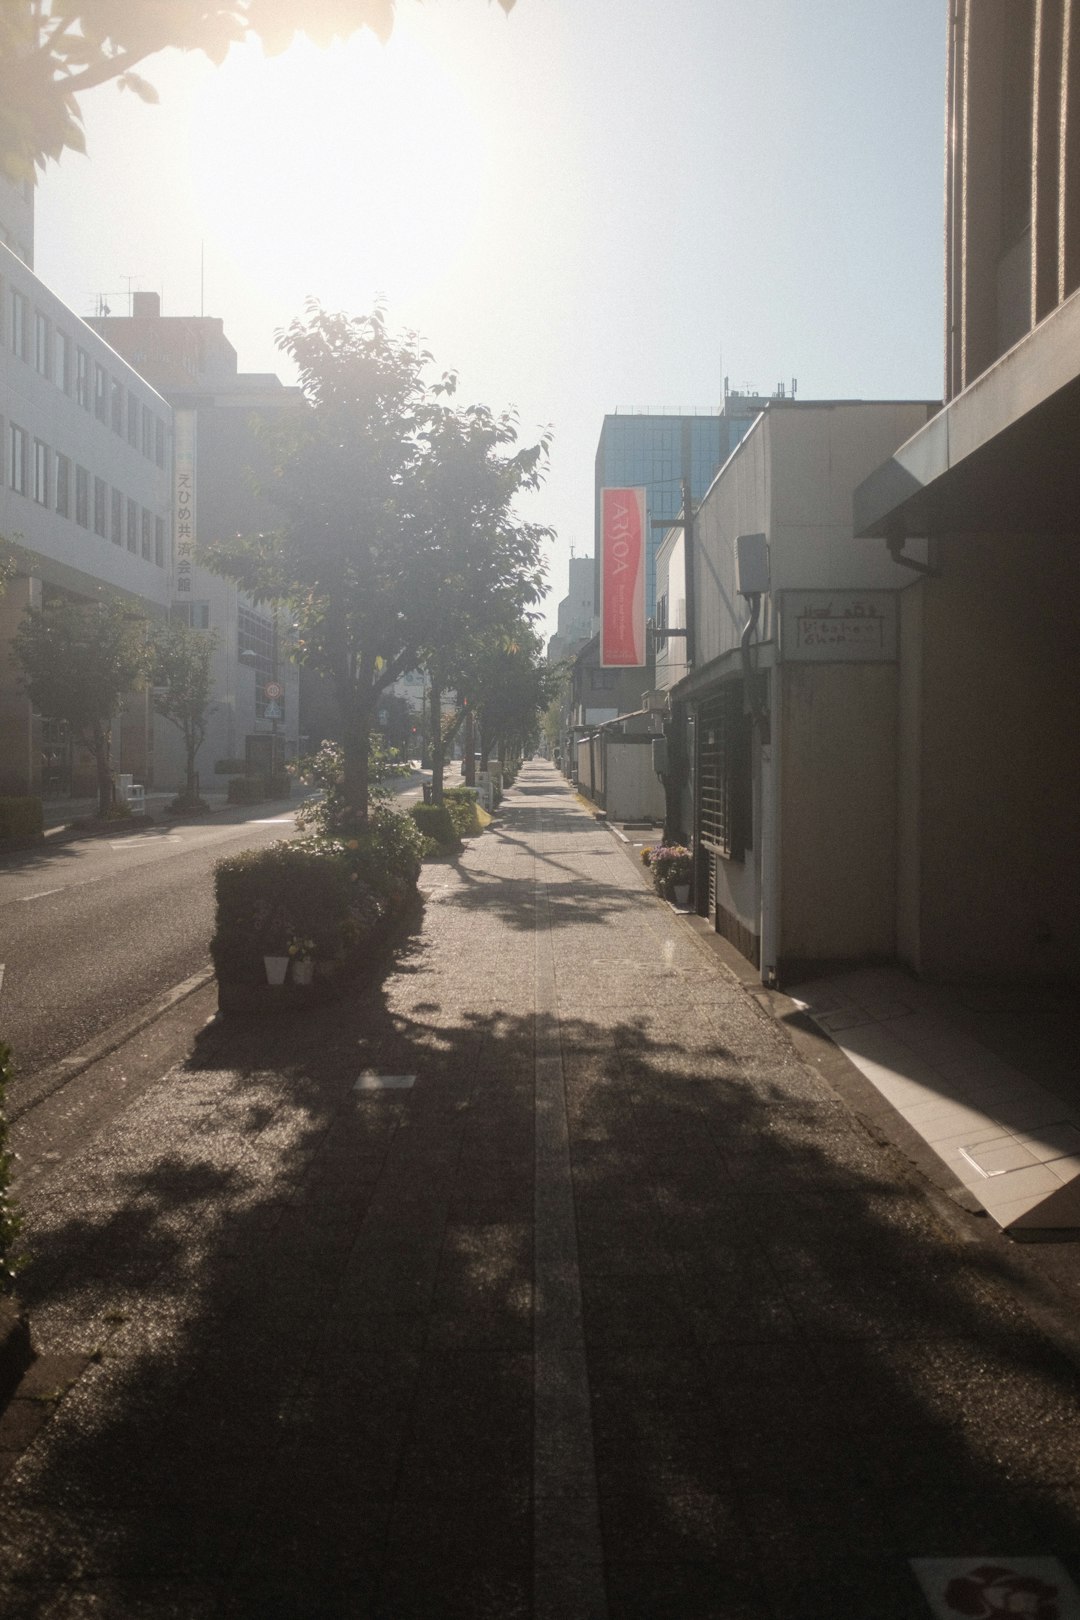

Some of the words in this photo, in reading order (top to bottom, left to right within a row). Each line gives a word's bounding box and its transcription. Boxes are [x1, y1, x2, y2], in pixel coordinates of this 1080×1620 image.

[177, 473, 192, 592] えひめ共済会館
[608, 502, 633, 575] ARSOA
